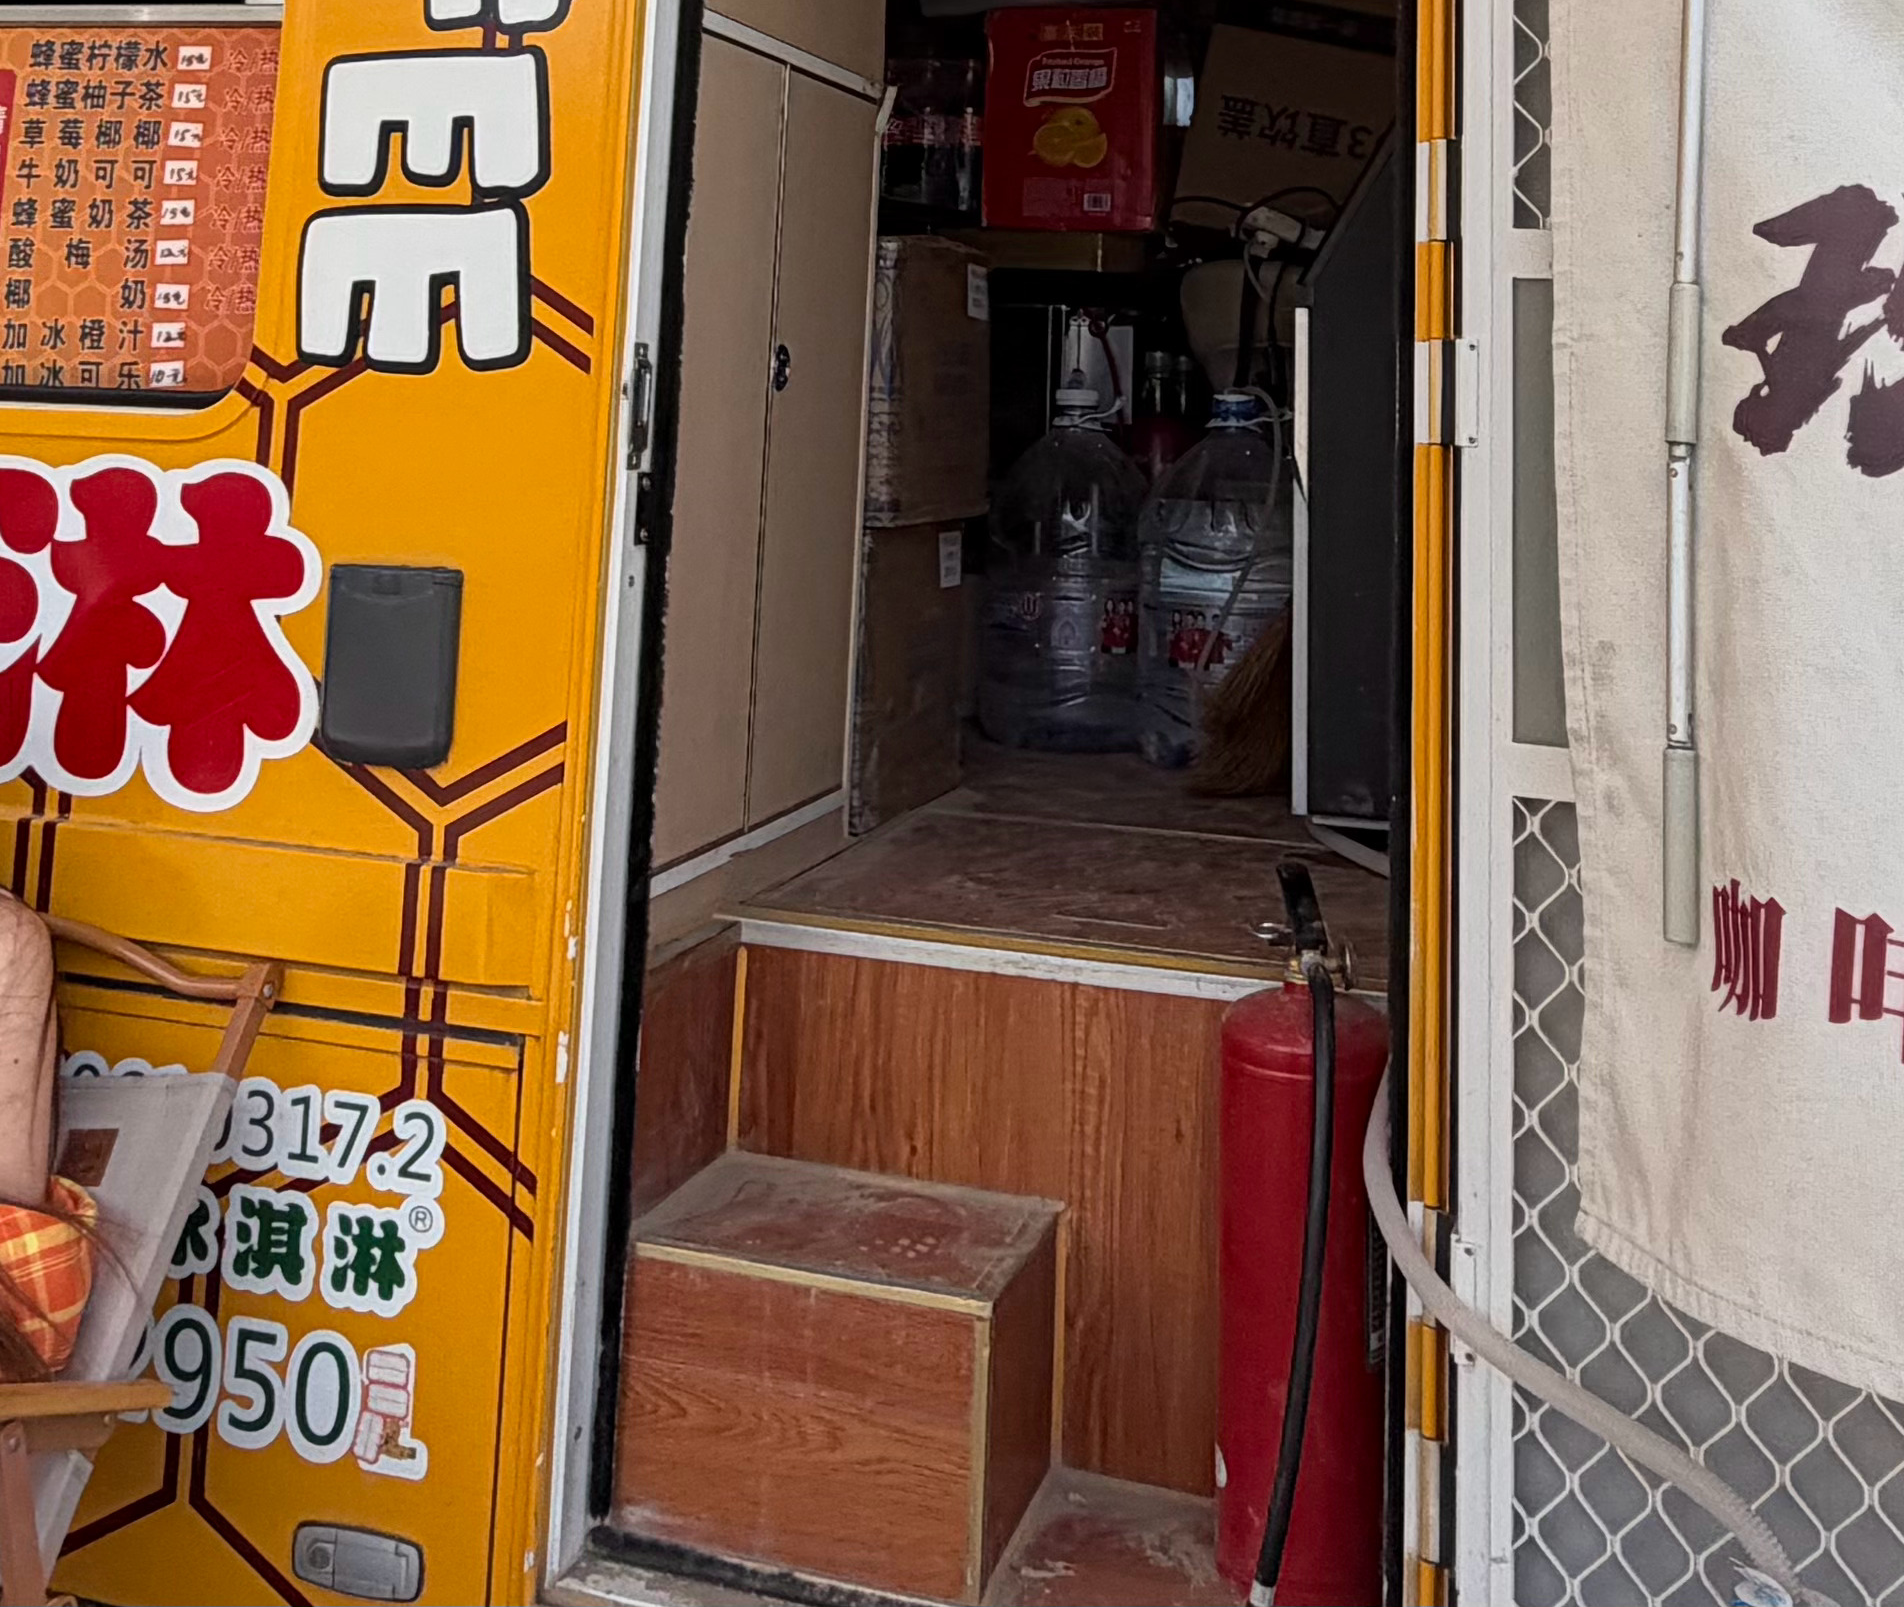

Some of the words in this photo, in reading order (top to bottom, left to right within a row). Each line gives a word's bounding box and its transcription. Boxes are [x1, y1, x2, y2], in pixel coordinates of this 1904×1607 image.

[29, 40, 168, 72] 蜂蜜柠檬水
[227, 49, 279, 74] 冷/热
[24, 79, 165, 111] 蜂蜜柚子茶
[223, 87, 275, 114] 冷/热
[20, 118, 162, 149] 草莓椰椰
[219, 126, 272, 153] 冷/热
[16, 158, 157, 190] 牛奶可可
[215, 166, 267, 193] 冷/热
[11, 198, 154, 230] 蜂蜜奶茶
[210, 205, 263, 233] 冷/热
[7, 238, 149, 270] 酸梅汤
[206, 245, 260, 272] 冷/热
[203, 287, 256, 315] 冷/热
[1, 318, 144, 351] 加冰橙汁
[1, 359, 141, 390] 加冰可乐
[216, 1089, 438, 1184] 317.2
[132, 1318, 351, 1447] 950
